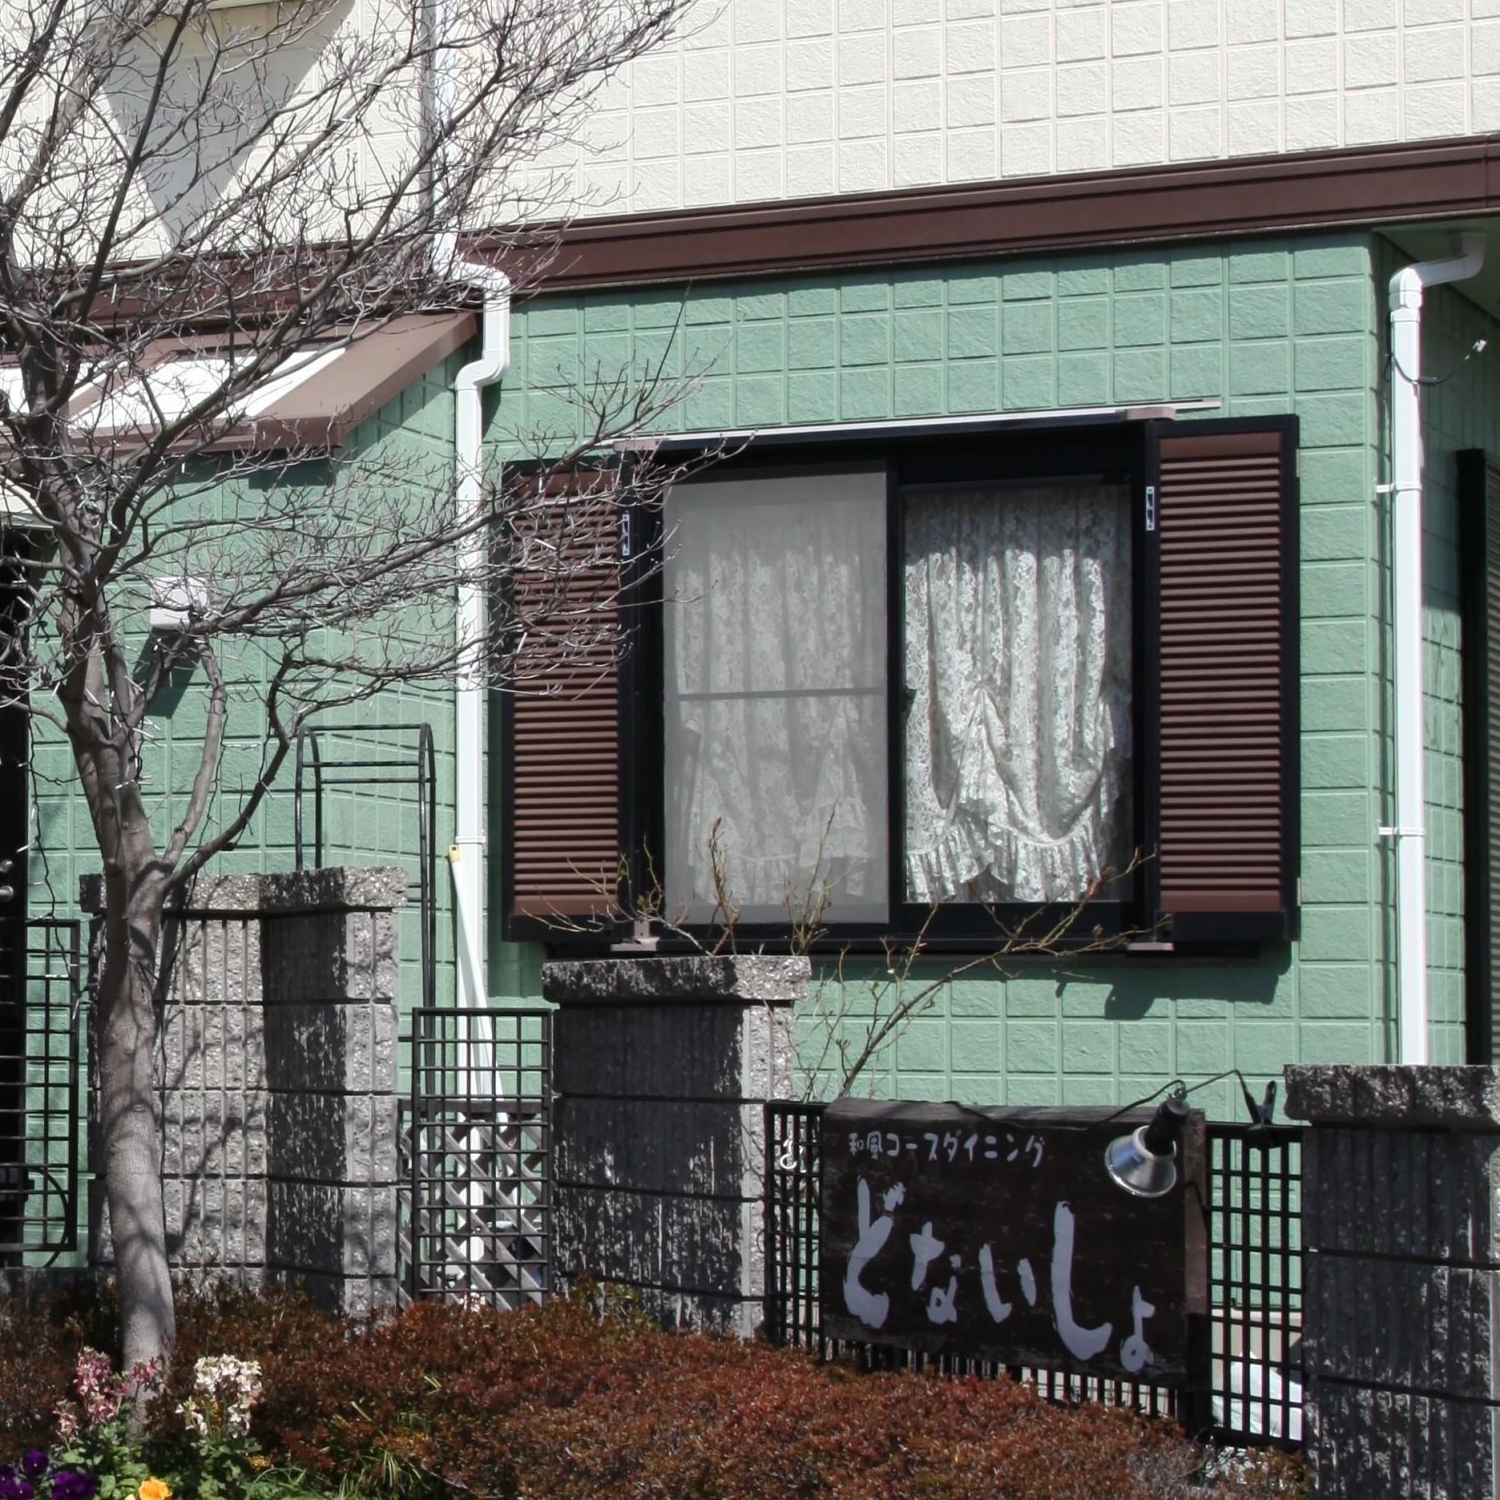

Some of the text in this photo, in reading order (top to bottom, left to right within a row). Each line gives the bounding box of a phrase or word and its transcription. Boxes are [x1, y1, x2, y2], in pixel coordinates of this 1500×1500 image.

[848, 1130, 1046, 1168] 和風コースダイニング
[842, 1174, 1156, 1374] どないしょ
